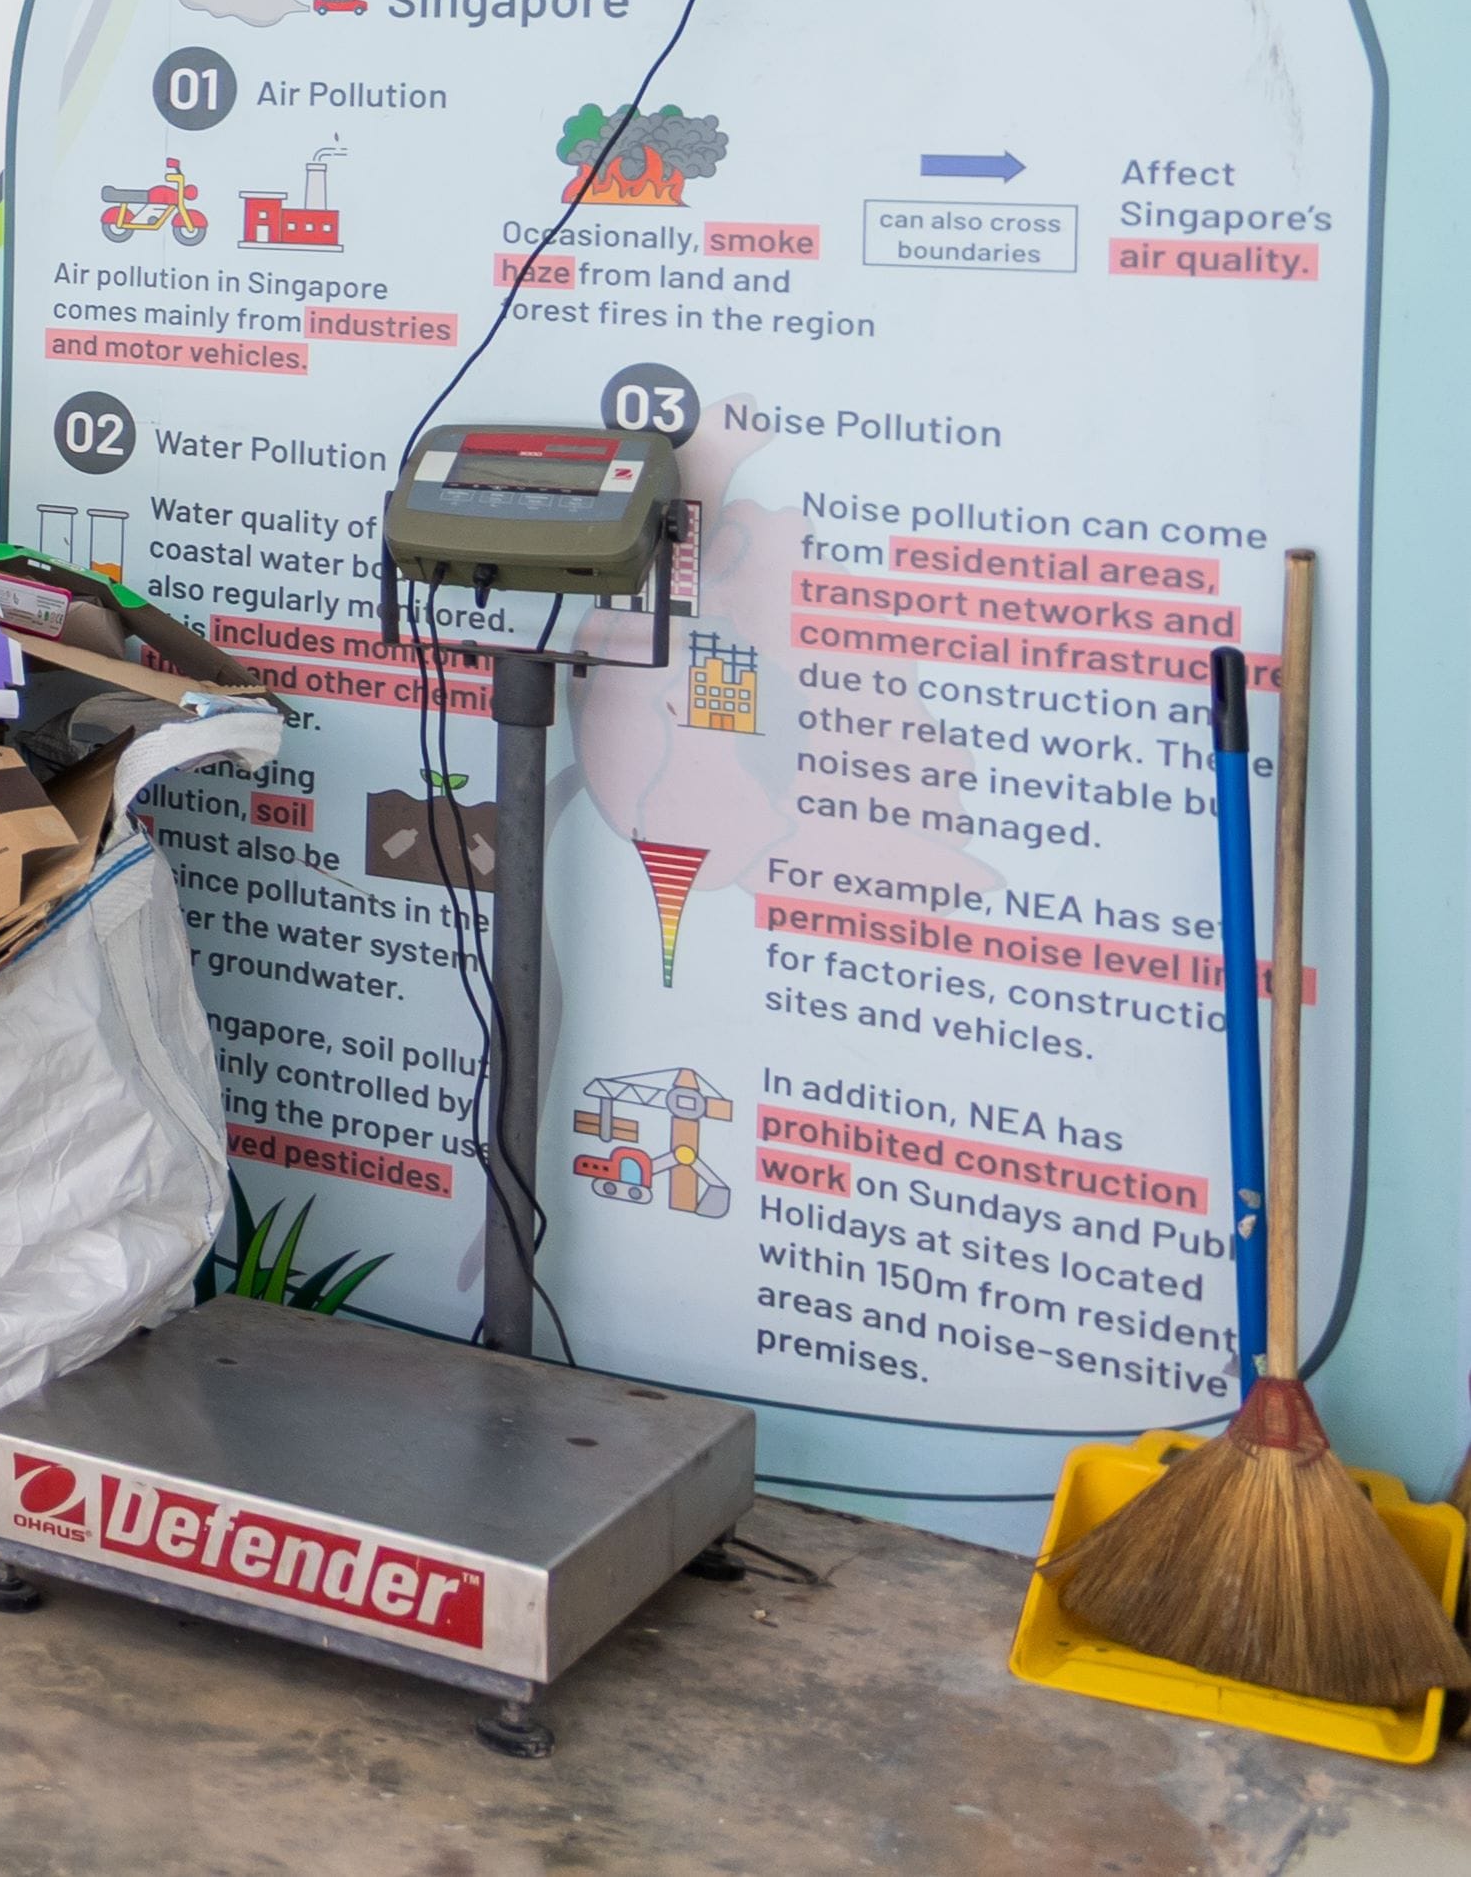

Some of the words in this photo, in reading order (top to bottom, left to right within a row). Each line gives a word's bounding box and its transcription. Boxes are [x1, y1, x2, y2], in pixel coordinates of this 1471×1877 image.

[170, 68, 218, 110] 01
[257, 81, 303, 108] Air
[309, 81, 448, 110] Pollution
[1122, 159, 1235, 187] Affect
[1121, 202, 1331, 235] Singapore's
[710, 227, 814, 256] smoke
[1120, 244, 1165, 273] air
[1175, 242, 1310, 278] quality.
[614, 384, 685, 433] 03
[725, 404, 824, 438] Noise
[837, 409, 1002, 447] Pollution
[65, 413, 124, 455] 02
[156, 429, 241, 458] Water
[251, 435, 387, 471] Pollution
[769, 858, 823, 889] For
[834, 873, 991, 915] example,
[1007, 890, 1082, 923] NEA
[1096, 899, 1159, 932] has
[761, 1114, 944, 1169] prohibited
[954, 1146, 1198, 1210] construction
[13, 1514, 85, 1542] OHAUS
[105, 1482, 460, 1626] Defender
